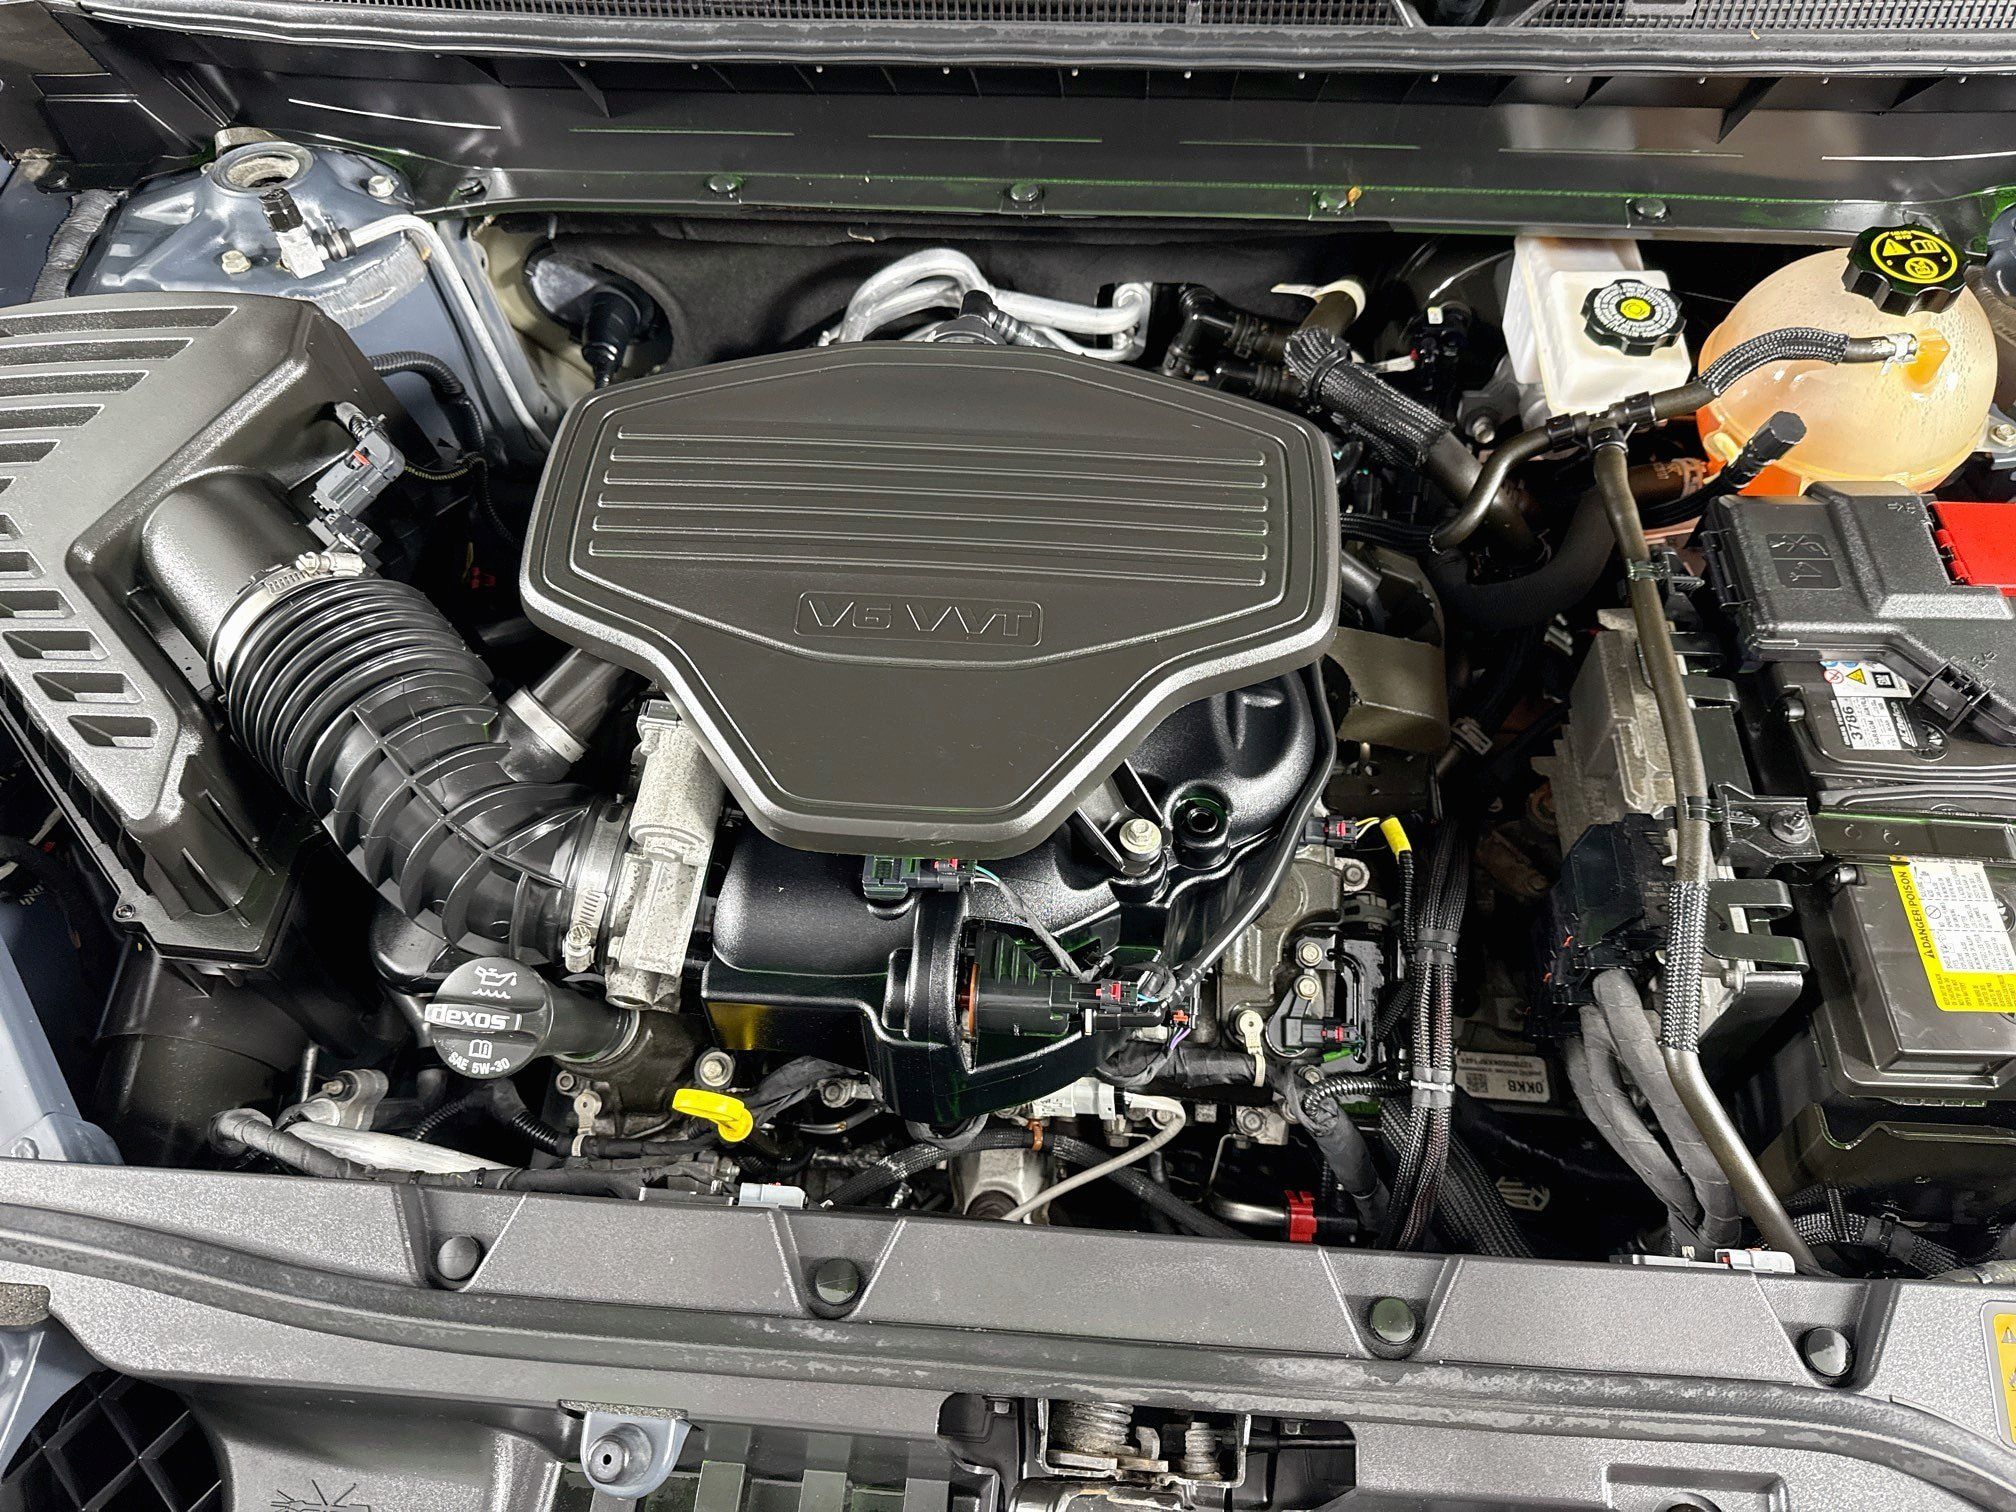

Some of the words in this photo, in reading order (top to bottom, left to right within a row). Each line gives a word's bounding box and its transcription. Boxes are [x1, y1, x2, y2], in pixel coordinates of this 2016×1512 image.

[808, 599, 892, 629] V6
[906, 603, 1032, 636] VVT
[1842, 706, 1863, 740] 3786
[431, 1004, 511, 1030] dexos
[448, 1051, 470, 1071] SAE
[471, 1057, 511, 1075] 5W-30
